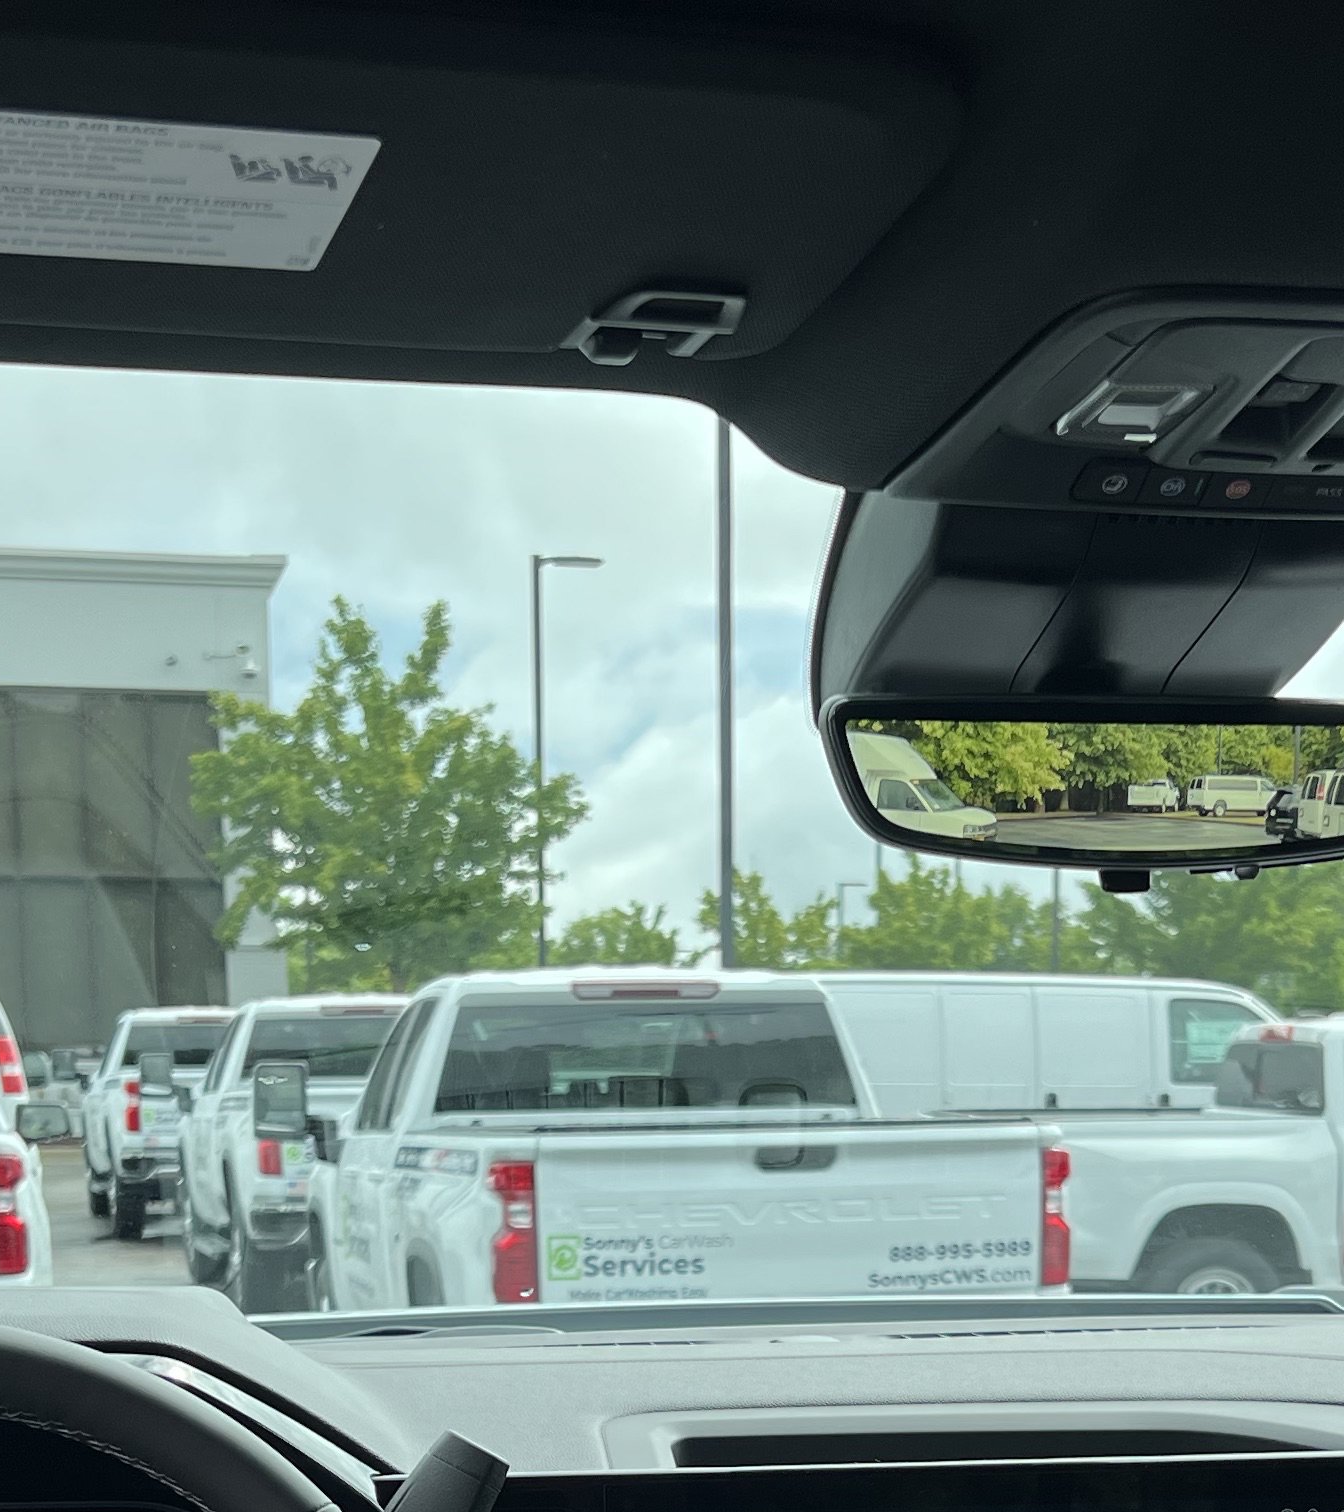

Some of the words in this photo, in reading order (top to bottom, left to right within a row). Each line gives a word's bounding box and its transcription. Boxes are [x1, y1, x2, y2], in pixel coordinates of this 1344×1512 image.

[577, 1193, 1008, 1229] CHEVROLET
[583, 1236, 655, 1253] Sonny's
[583, 1252, 706, 1278] Services
